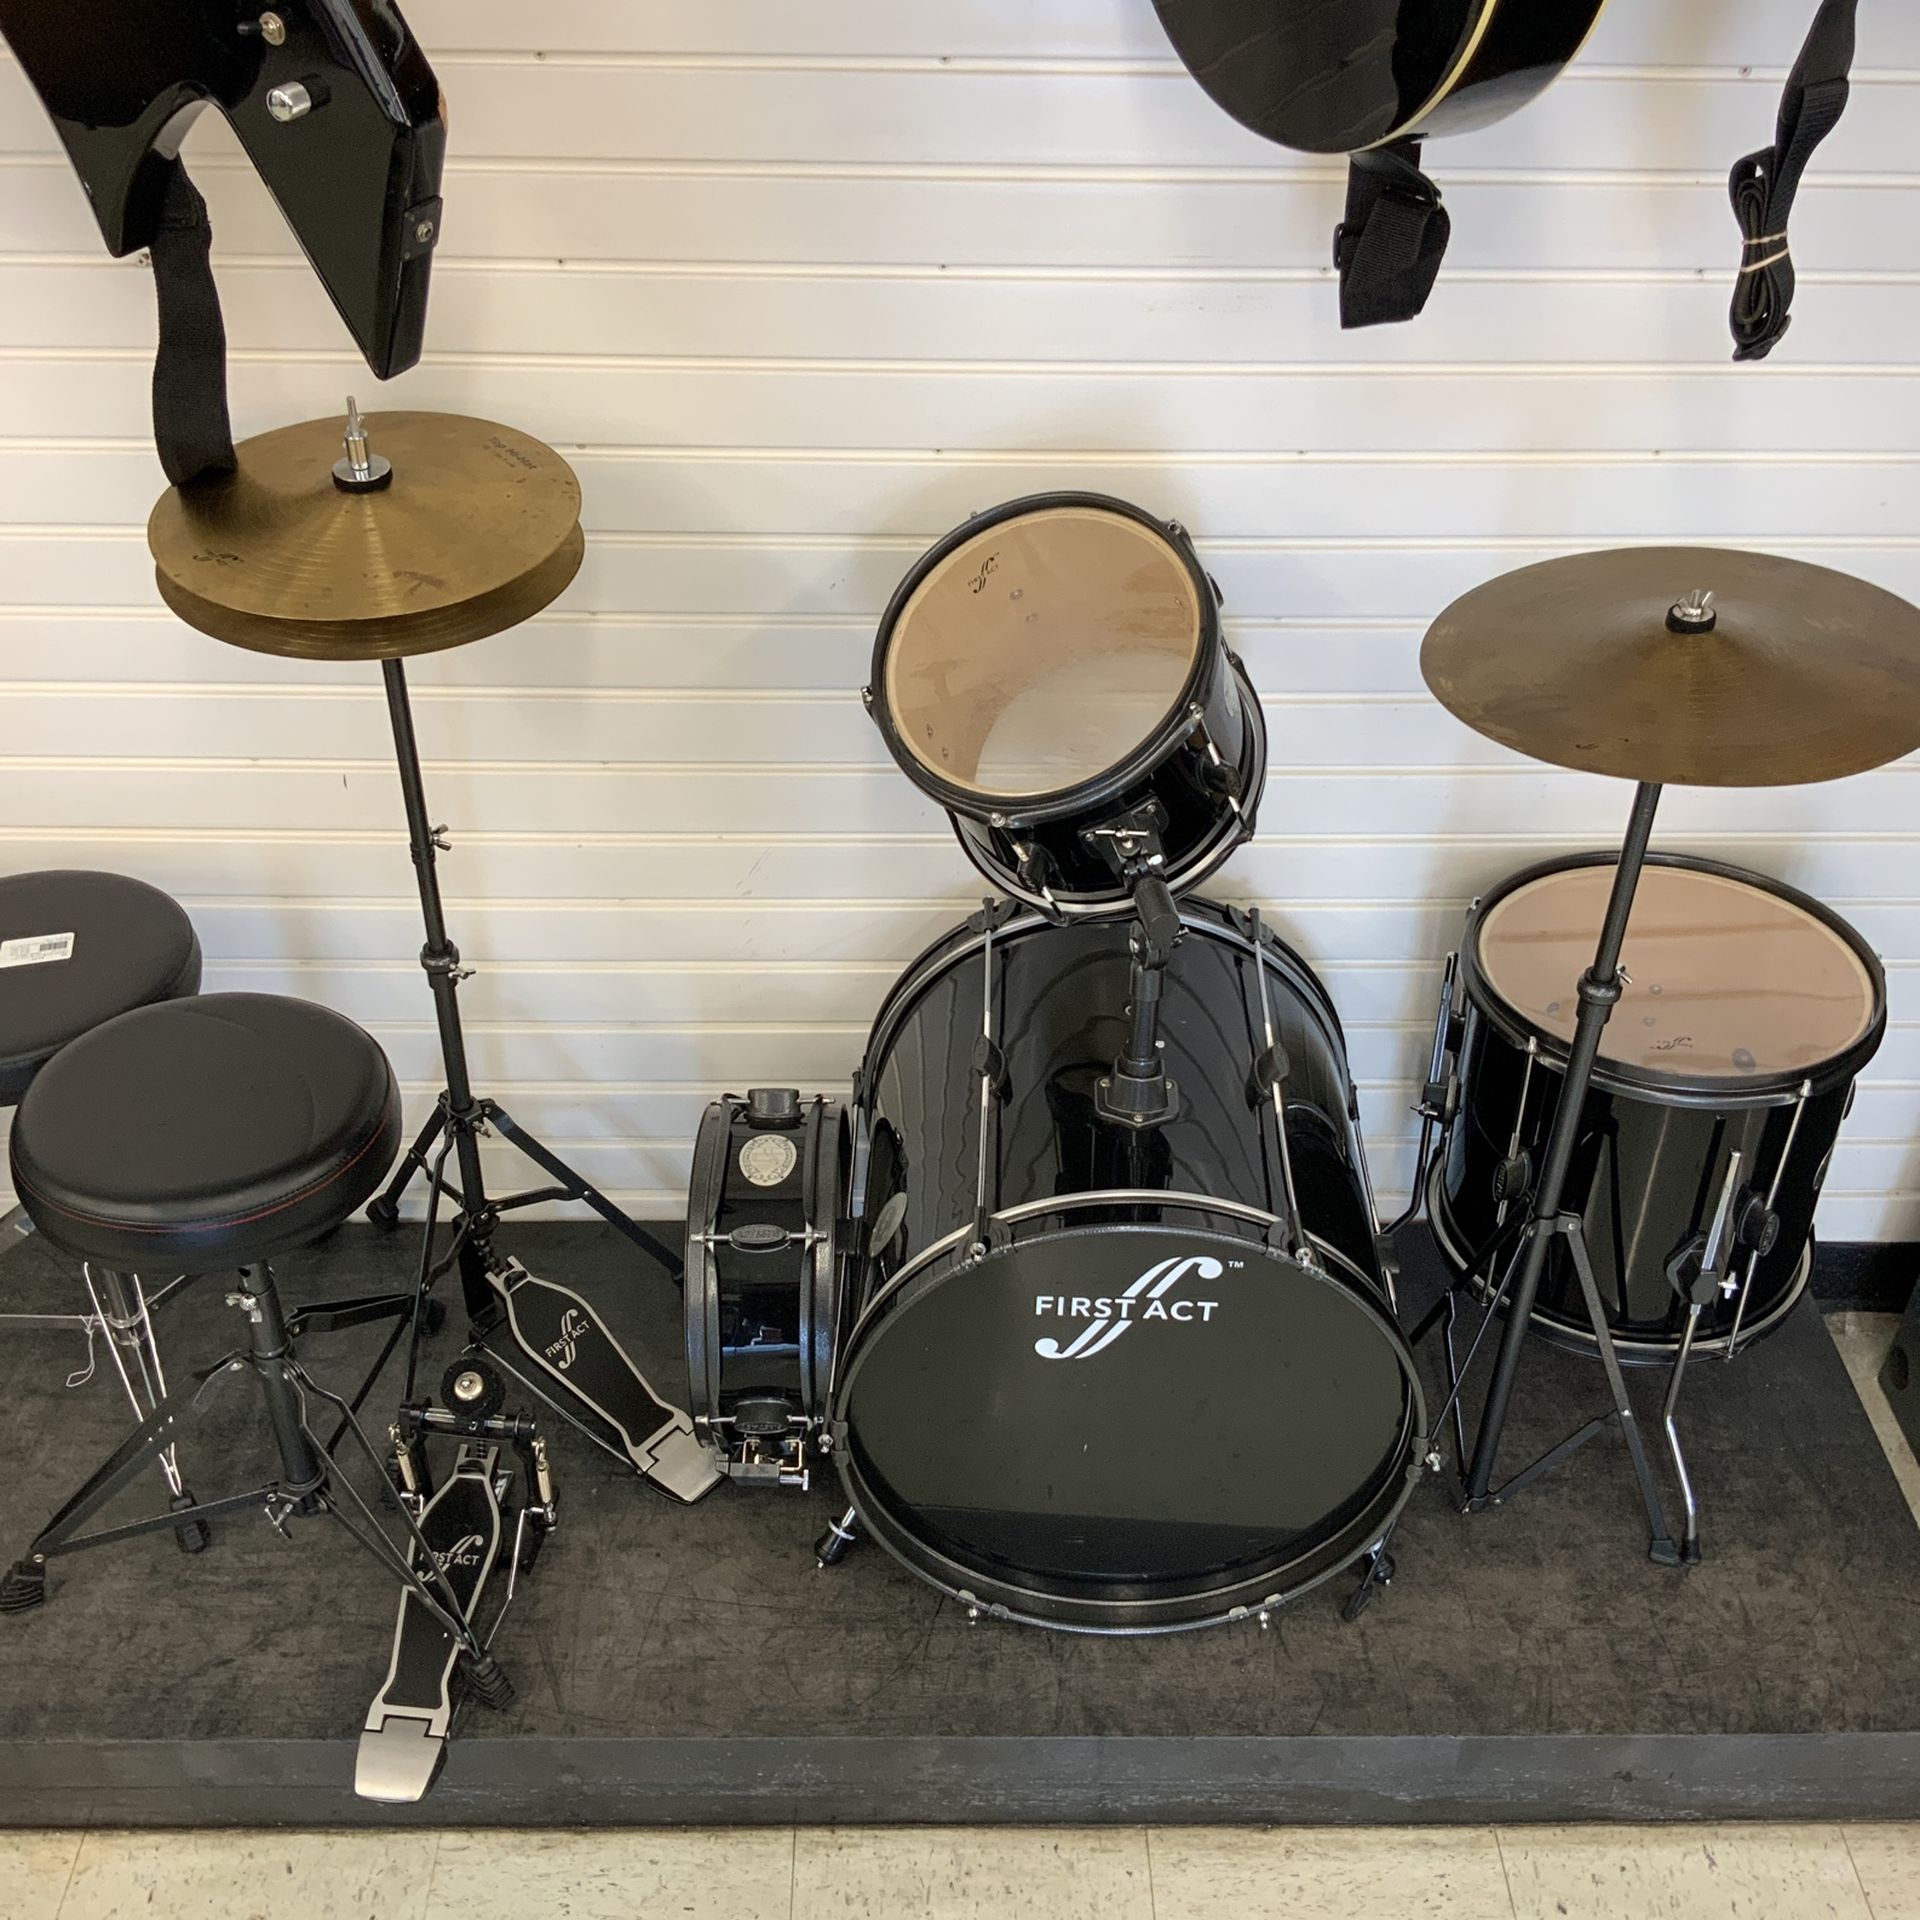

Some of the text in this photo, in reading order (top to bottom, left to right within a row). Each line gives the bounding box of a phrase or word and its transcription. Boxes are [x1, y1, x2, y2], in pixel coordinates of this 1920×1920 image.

[1035, 1295, 1219, 1322] FIRST ACT
[544, 1319, 590, 1358] FIRST ACT
[453, 1554, 480, 1566] ACT
